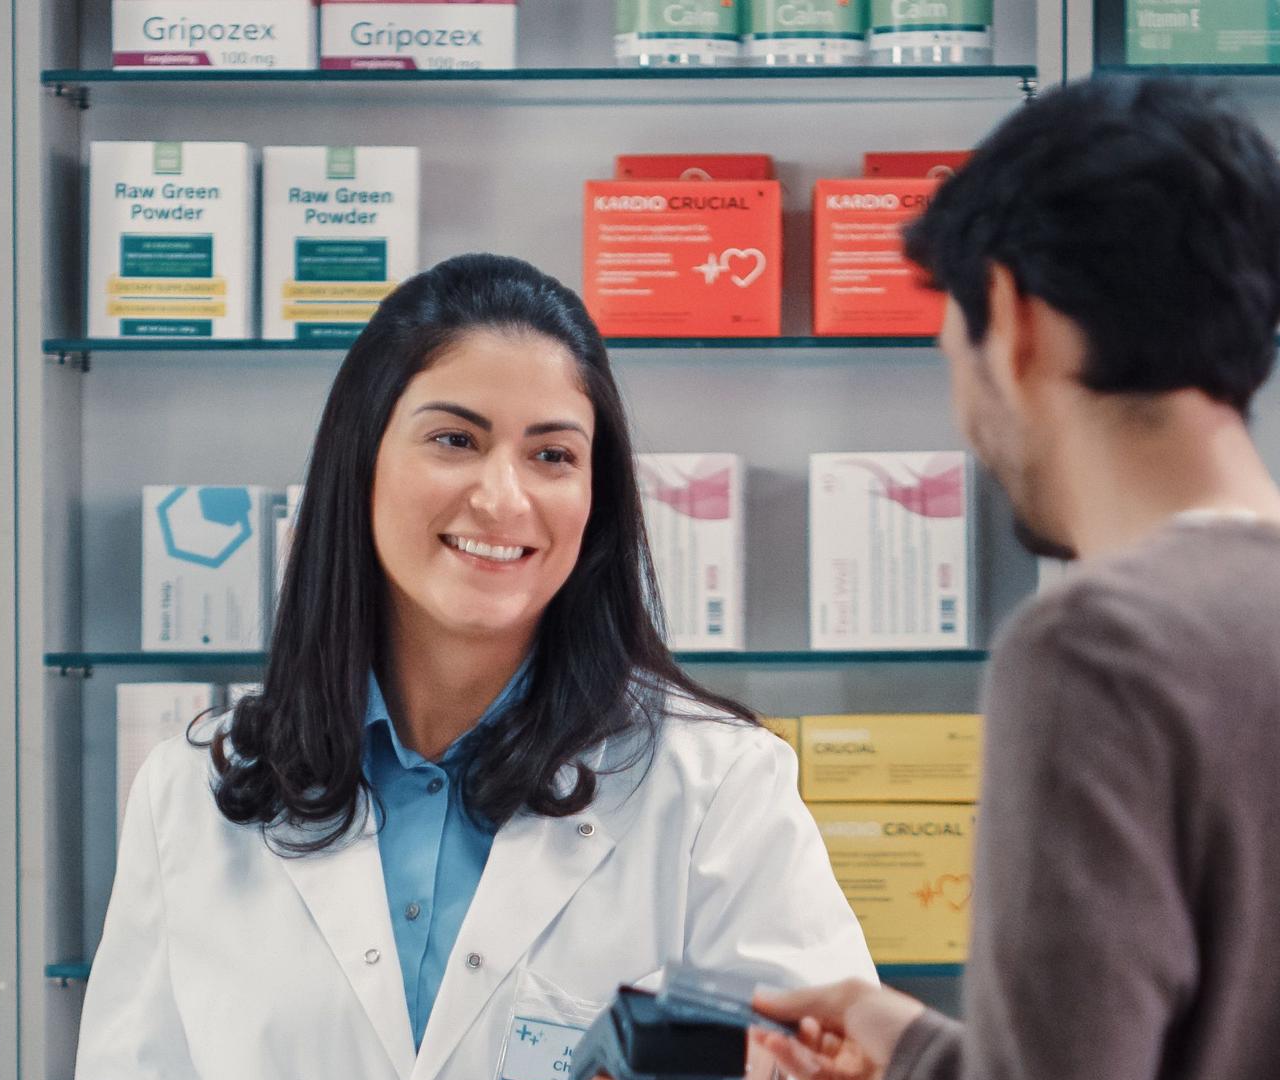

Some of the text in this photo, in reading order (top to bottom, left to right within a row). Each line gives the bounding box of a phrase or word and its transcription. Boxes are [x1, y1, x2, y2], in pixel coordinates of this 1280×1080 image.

[664, 4, 718, 27] Calm
[776, 4, 833, 27] Calm
[890, 0, 947, 21] Calm
[142, 17, 275, 46] Gripozex
[350, 22, 482, 52] Gripozex
[221, 52, 248, 65] 100
[115, 183, 219, 200] Raw Green
[287, 187, 394, 205] Raw Green
[667, 195, 751, 211] CRUCIAL
[130, 204, 204, 221] Powder
[304, 209, 378, 225] Powder
[883, 821, 963, 837] CRUCIAL
